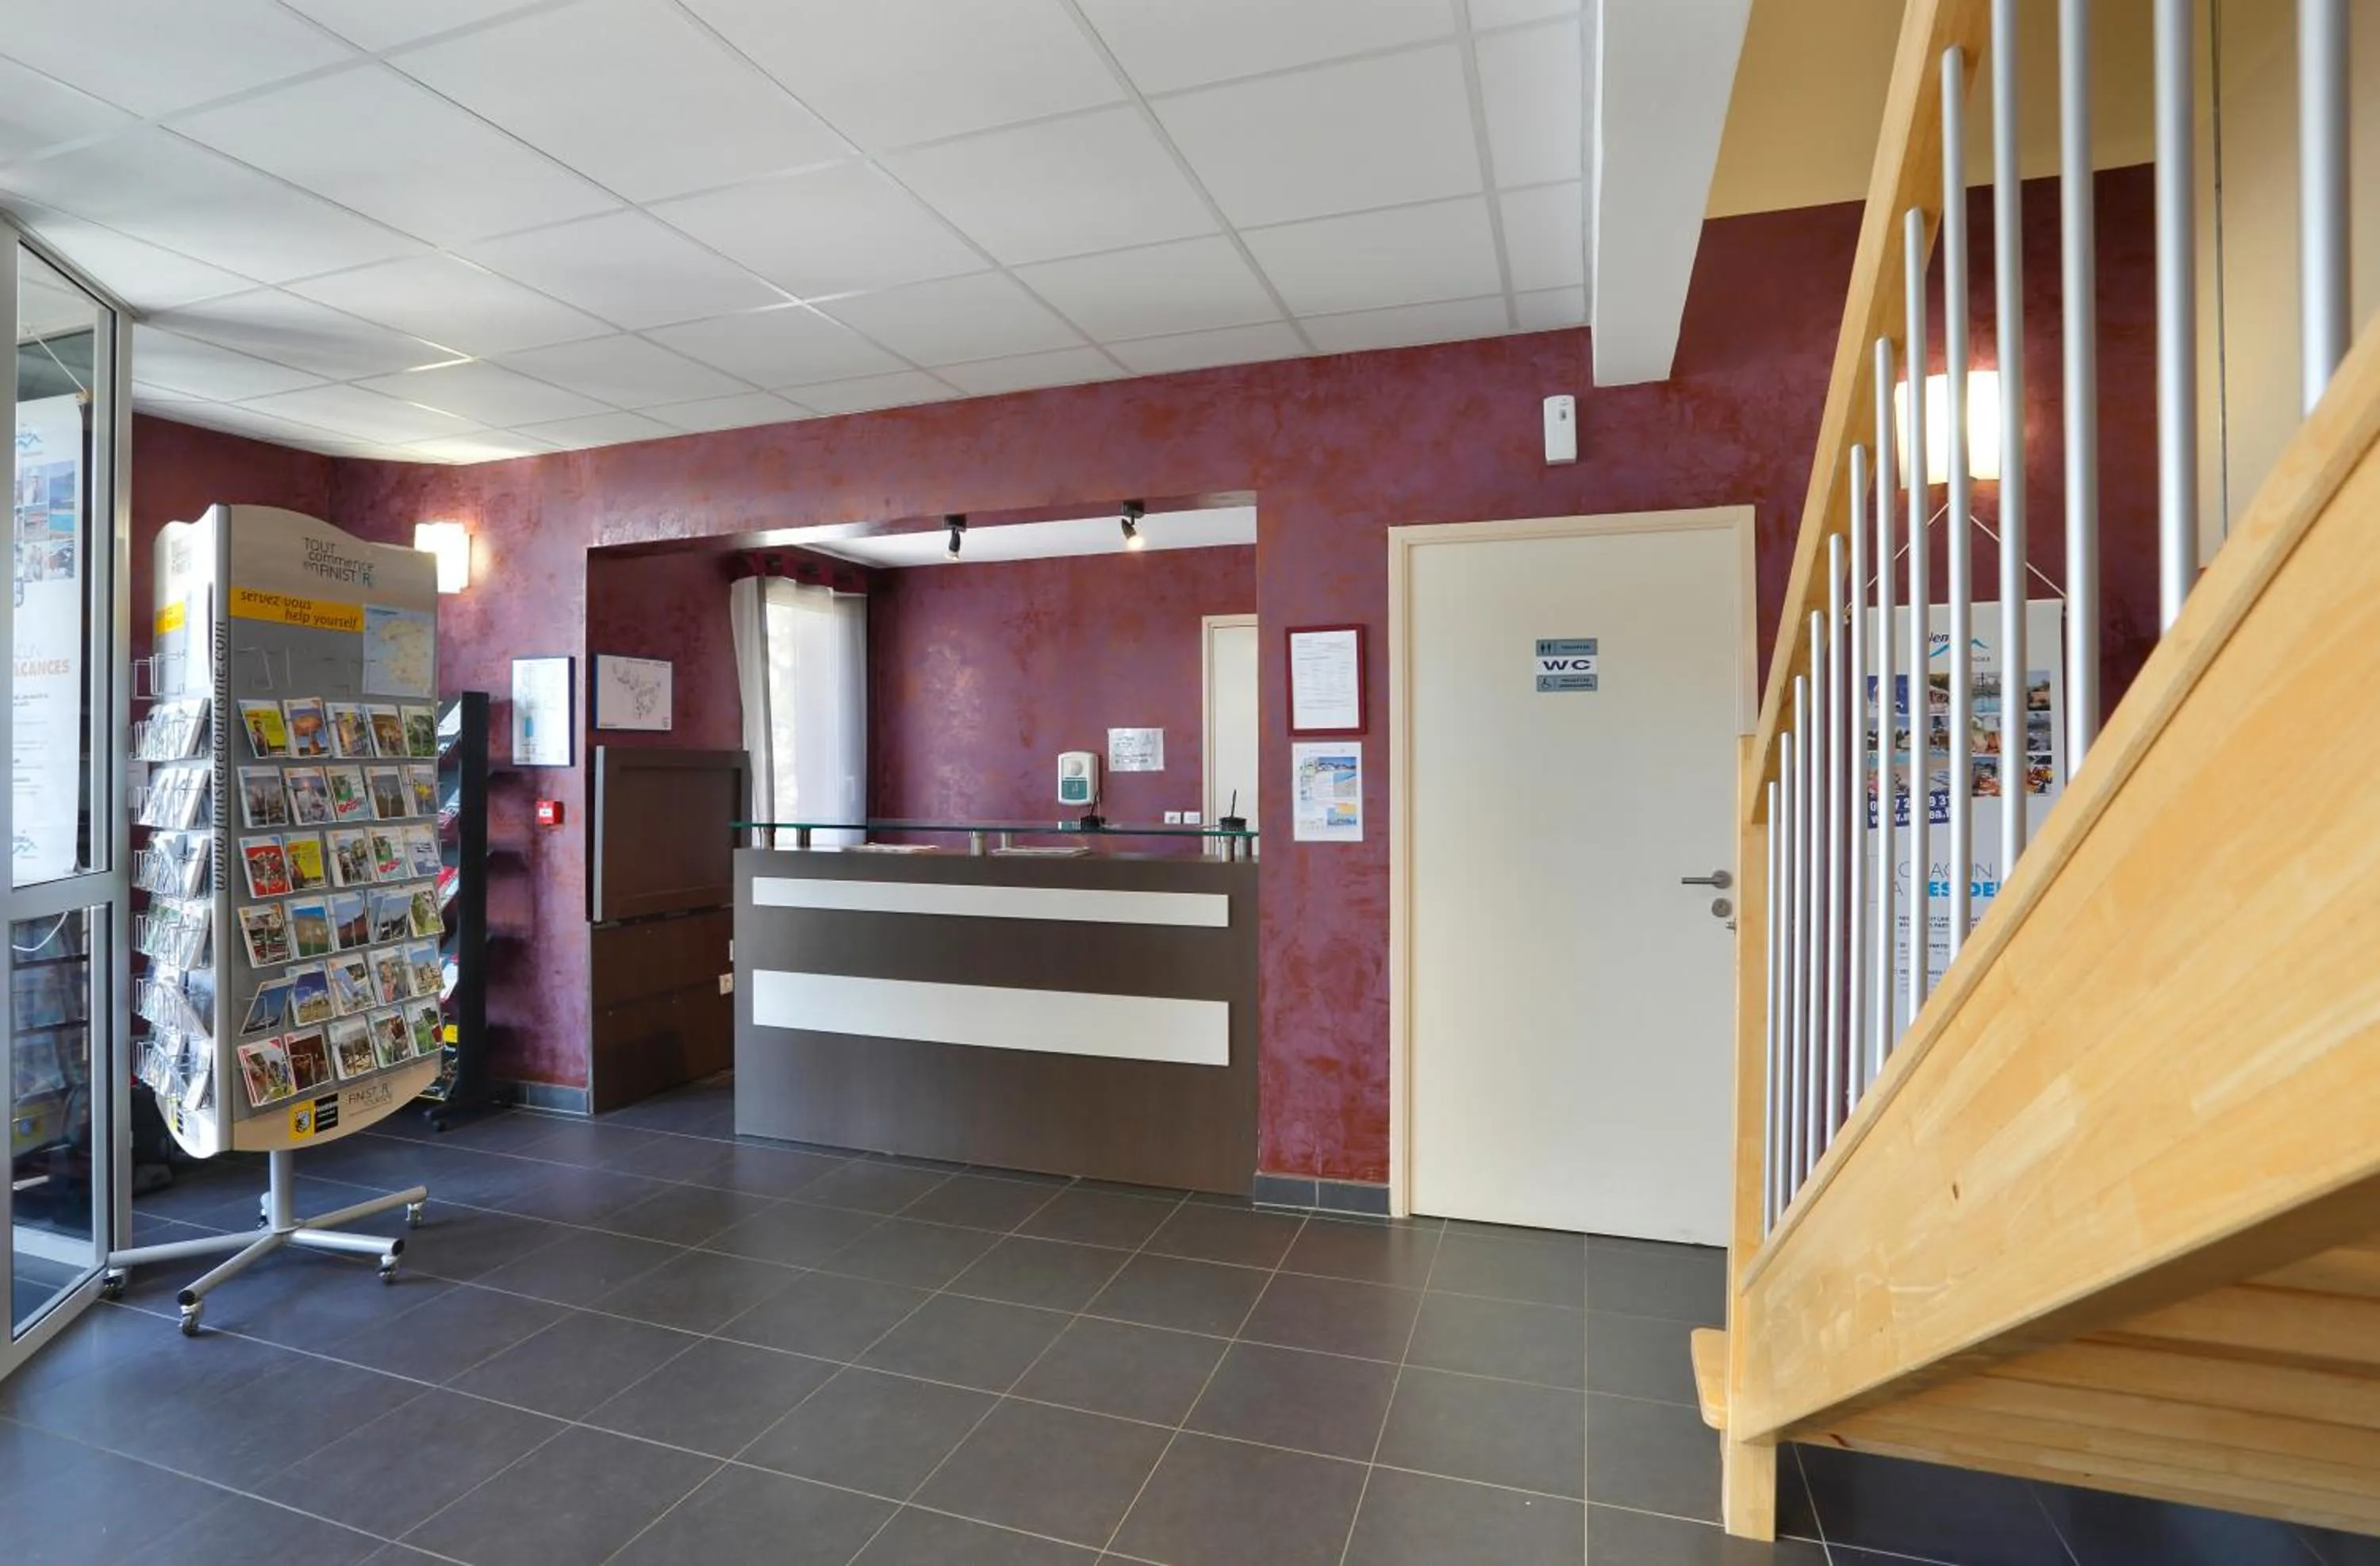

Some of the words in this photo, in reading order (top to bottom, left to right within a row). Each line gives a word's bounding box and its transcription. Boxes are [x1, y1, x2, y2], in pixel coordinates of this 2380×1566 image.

[302, 537, 336, 554] TOUT
[308, 551, 375, 572] commence
[285, 608, 309, 624] help
[313, 612, 358, 629] yourself
[1543, 659, 1591, 670] WC
